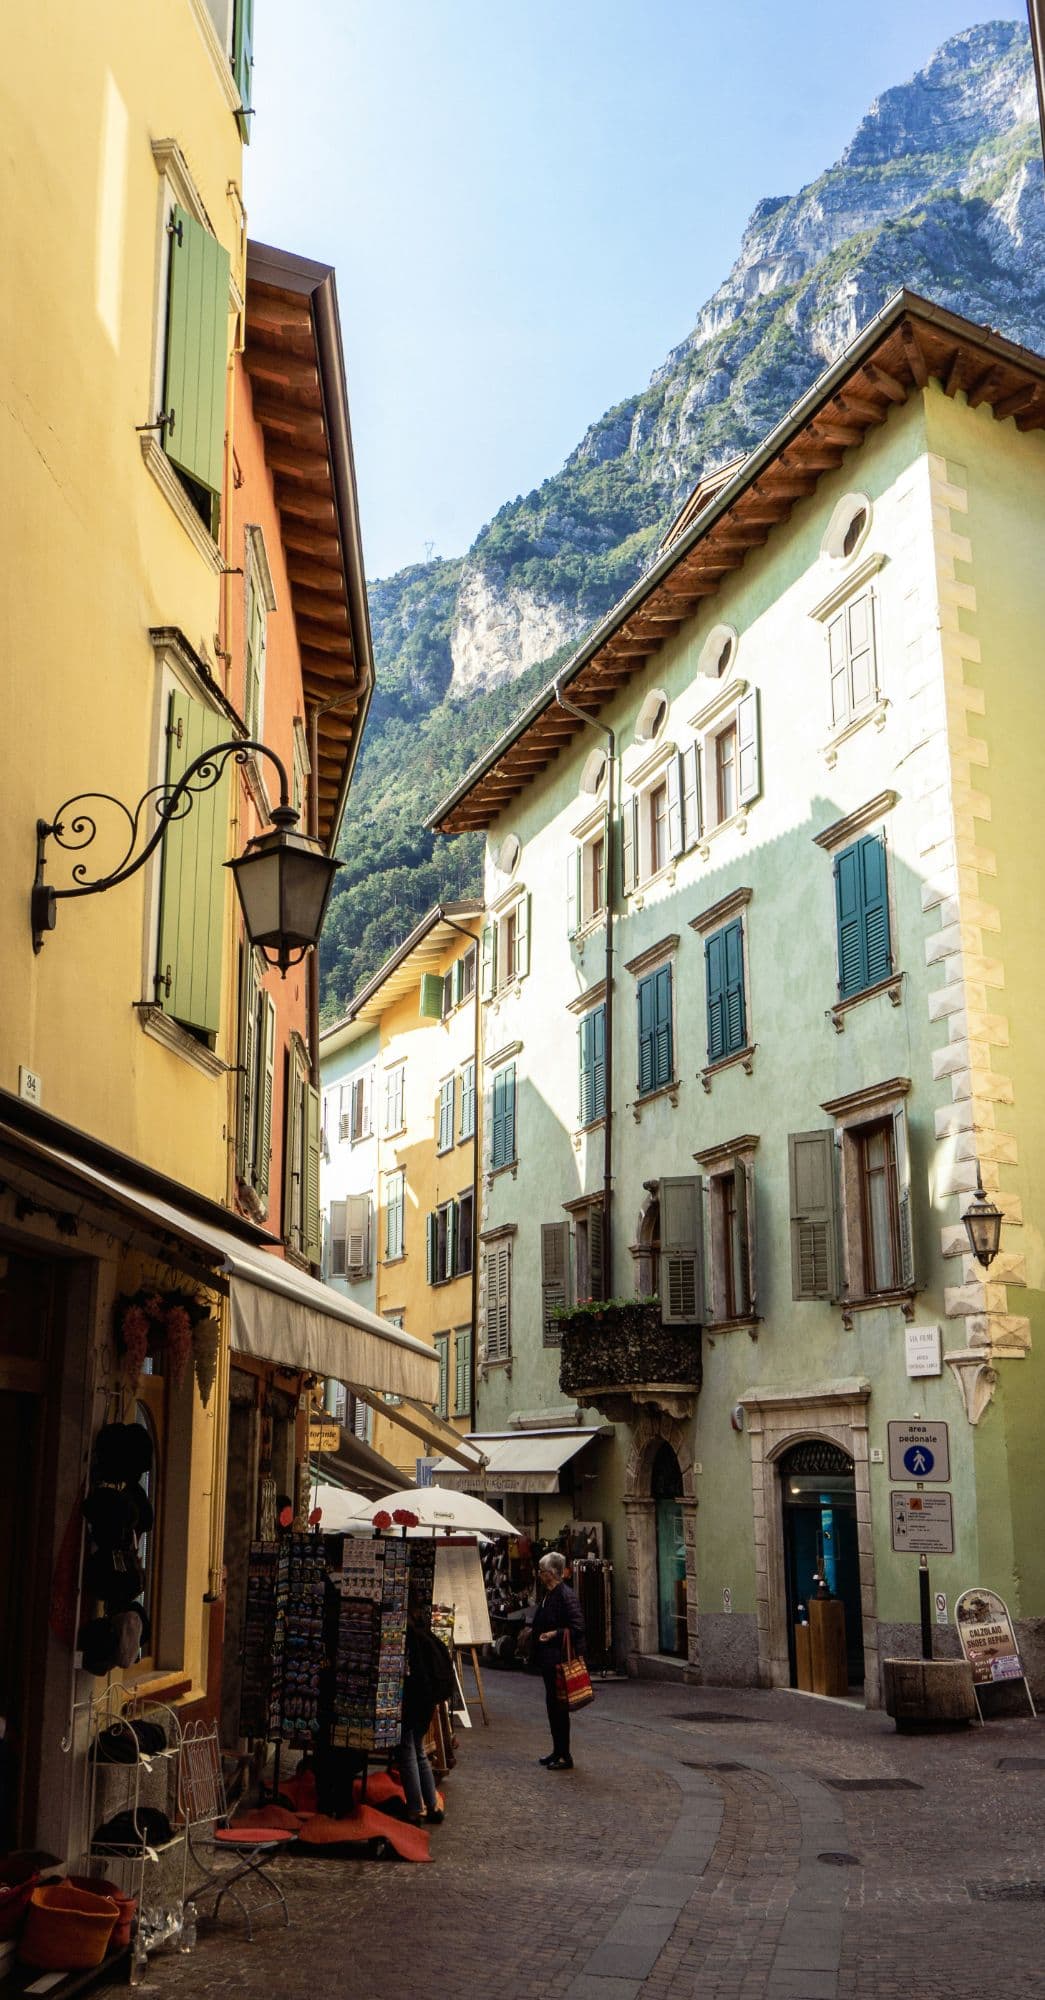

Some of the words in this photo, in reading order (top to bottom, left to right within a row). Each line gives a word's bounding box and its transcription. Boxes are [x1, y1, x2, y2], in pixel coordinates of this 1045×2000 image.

[899, 1435, 938, 1443] pedonale
[969, 1625, 1002, 1638] CALZOLAIO
[967, 1638, 987, 1649] SHOES
[987, 1634, 1010, 1646] REPAIR
